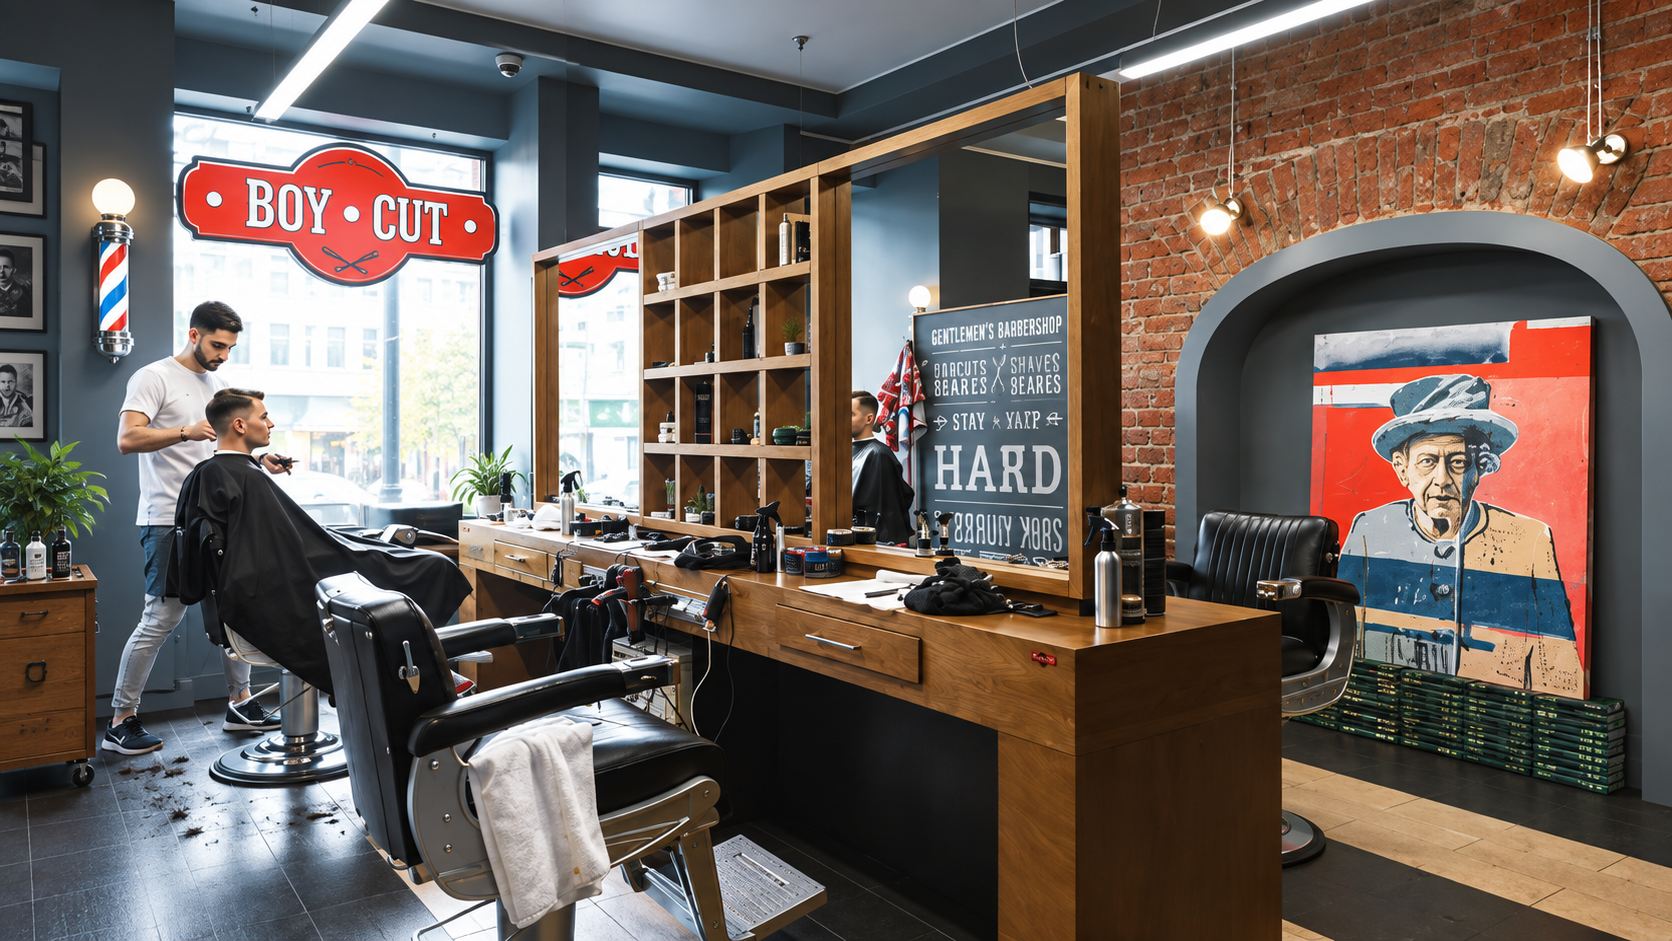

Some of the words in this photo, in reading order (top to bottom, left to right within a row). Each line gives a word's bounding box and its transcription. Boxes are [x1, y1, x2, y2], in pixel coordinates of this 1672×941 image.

[245, 177, 333, 235] BOY
[372, 193, 448, 246] CUT
[931, 322, 994, 346] GENTLEMEN'S
[998, 315, 1062, 339] BARBERSHOP
[1010, 352, 1060, 375] SHAVES
[952, 412, 986, 431] STAY
[934, 445, 1062, 495] HARD
